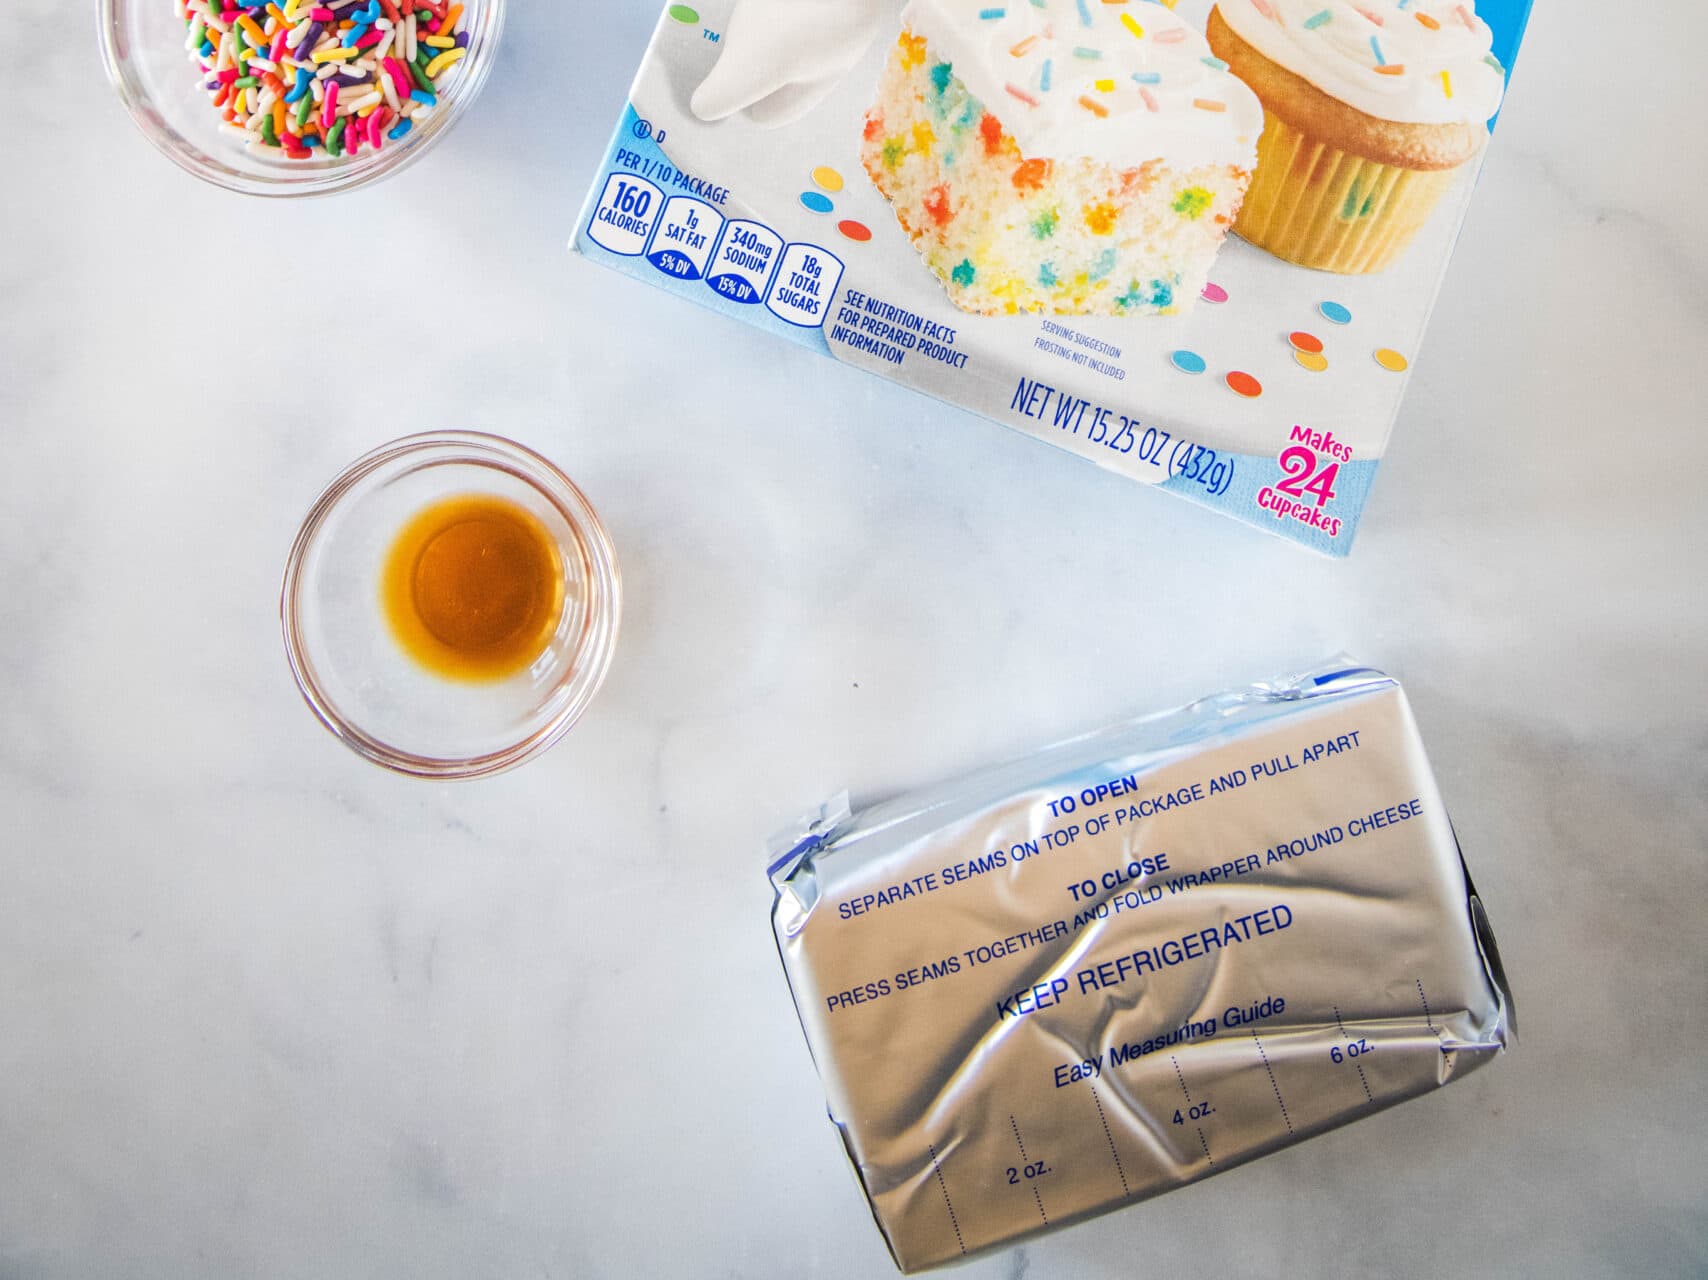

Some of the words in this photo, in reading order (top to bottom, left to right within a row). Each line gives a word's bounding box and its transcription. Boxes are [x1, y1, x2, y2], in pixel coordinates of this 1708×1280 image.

[615, 148, 641, 170] PER
[641, 158, 672, 183] 1/10
[672, 170, 731, 206] PACKAGE
[612, 181, 651, 218] 160
[685, 208, 700, 230] 1g
[598, 206, 649, 237] CALORIES
[664, 223, 687, 242] SAT
[686, 231, 708, 250] FAT
[723, 246, 768, 275] SODIUM
[730, 226, 773, 259] 340mg
[659, 253, 676, 270] 5%
[676, 258, 691, 276] DV
[789, 271, 821, 297] TOTAL
[801, 254, 823, 279] 18g
[717, 276, 737, 295] 15%
[736, 284, 753, 300] DV
[776, 287, 821, 315] SUGARS
[844, 289, 866, 309] SEE
[864, 297, 924, 333] NUTRITION
[922, 320, 957, 345] FACTS
[830, 324, 906, 365] INFORMATION
[837, 307, 860, 328] FOR
[860, 316, 917, 349] PREPARED
[916, 338, 969, 369] PRODUCT
[1041, 319, 1075, 341] SERVING
[1074, 333, 1122, 359] SUGGESTION
[1034, 337, 1072, 360] FROSTING
[1071, 351, 1089, 366] NOT
[1088, 359, 1126, 381] INCLUDED
[1010, 376, 1051, 421] NET
[1053, 391, 1092, 435] WT
[1086, 407, 1141, 455] 15.25
[1138, 426, 1173, 468] OZ
[1166, 439, 1236, 497] (432g)
[1288, 424, 1355, 463] Makes
[1275, 444, 1342, 508] 24
[1256, 486, 1344, 537] Cupcakes
[1047, 795, 1076, 818] TO
[1080, 774, 1139, 807] OPEN
[838, 872, 939, 920] SEPARATE
[941, 849, 1008, 887] SEAMS
[1010, 839, 1040, 863] ON
[1041, 824, 1081, 851] TOP
[1085, 813, 1111, 837] OF
[1115, 782, 1205, 826] PACKAGE
[1209, 769, 1248, 797] AND
[1251, 753, 1300, 782] PULL
[1302, 730, 1363, 766] APART
[1066, 879, 1098, 903] TO
[1101, 852, 1171, 891] CLOSE
[826, 978, 892, 1014] PRESS
[895, 955, 962, 991] SEAMS
[963, 919, 1069, 968] TOGETHER
[1073, 901, 1110, 931] AND
[1113, 884, 1163, 914] FOLD
[1165, 853, 1262, 895] WRAPPER
[1265, 826, 1345, 866] AROUND
[1346, 798, 1424, 838] CHEESE
[995, 977, 1070, 1023] KEEP
[1077, 904, 1294, 996] REFRIGERATED
[1054, 1055, 1105, 1089] Easy
[1109, 1018, 1218, 1068] Measuring
[1223, 993, 1287, 1029] Guide
[1330, 1046, 1343, 1065] 6
[1346, 1040, 1376, 1059] oz.
[1171, 1109, 1185, 1127] 4
[1188, 1101, 1217, 1122] oz.
[1005, 1166, 1020, 1186] 2
[1023, 1158, 1053, 1180] oz.
